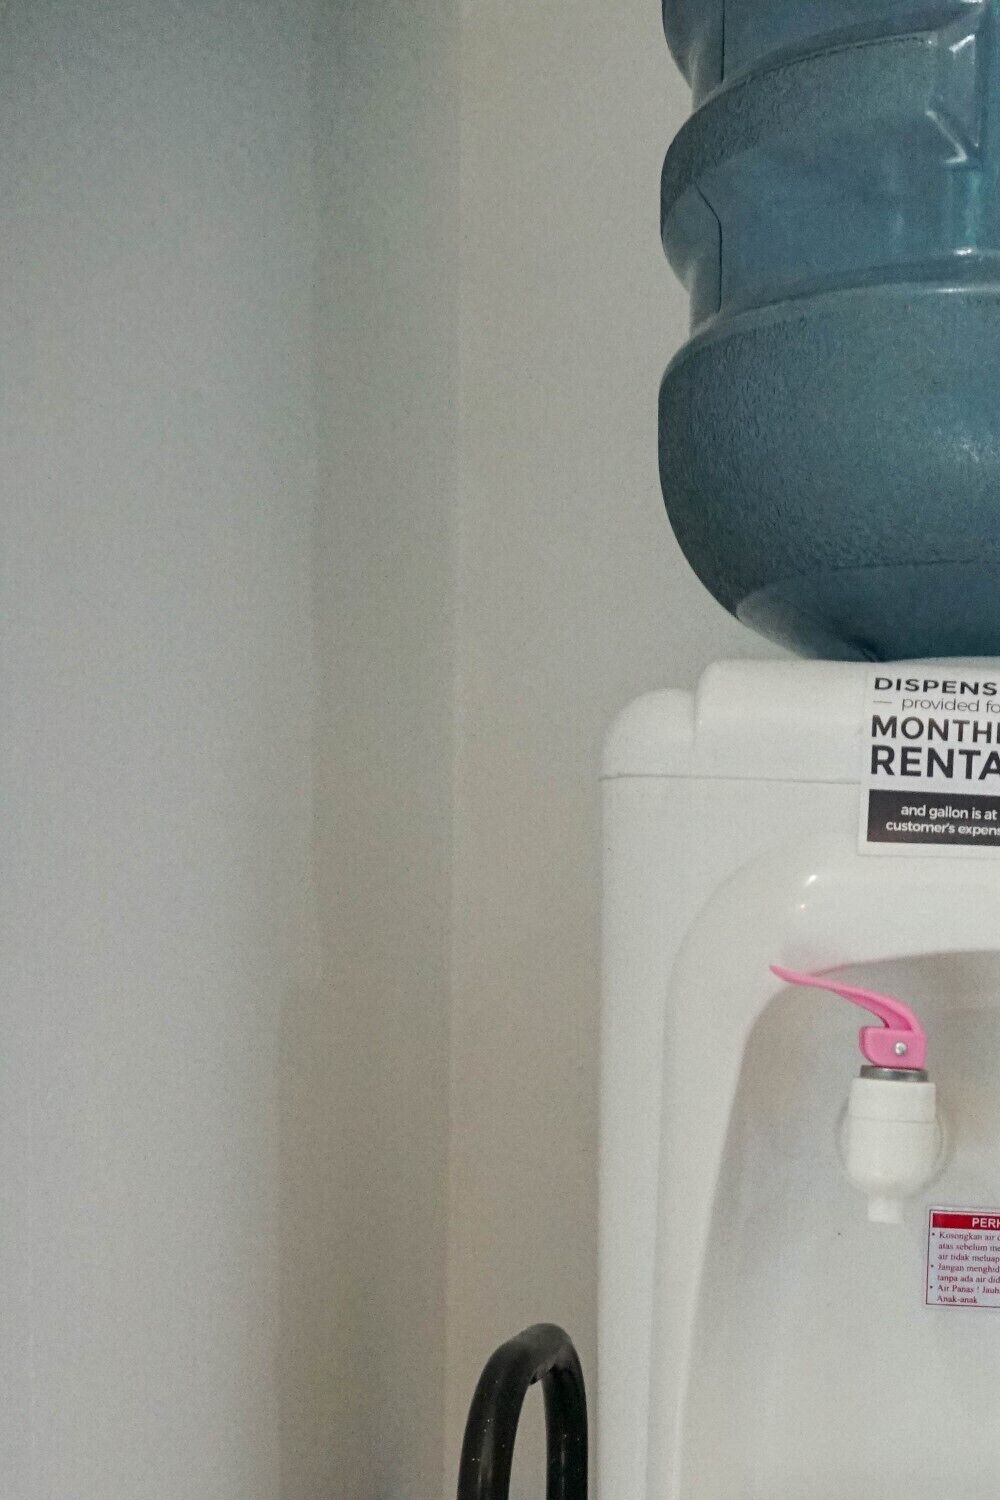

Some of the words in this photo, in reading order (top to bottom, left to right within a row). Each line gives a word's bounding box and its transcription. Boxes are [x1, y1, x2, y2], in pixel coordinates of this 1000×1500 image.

[902, 698, 980, 712] provided
[900, 805, 926, 816] and
[929, 806, 969, 820] gallon
[971, 807, 981, 820] is
[984, 809, 998, 821] at
[885, 820, 955, 834] customer's
[939, 1231, 982, 1241] Kosongkan
[984, 1232, 995, 1240] air
[956, 1243, 987, 1251] sebelum
[937, 1253, 948, 1261] air
[950, 1253, 969, 1261] tidak
[972, 1254, 1000, 1263] meluap
[937, 1263, 964, 1273] Jangan
[937, 1274, 958, 1283] tanpa
[960, 1275, 974, 1283] ada
[937, 1284, 950, 1292] Air
[952, 1284, 974, 1293] Panas
[937, 1295, 978, 1304] Anak-anak
